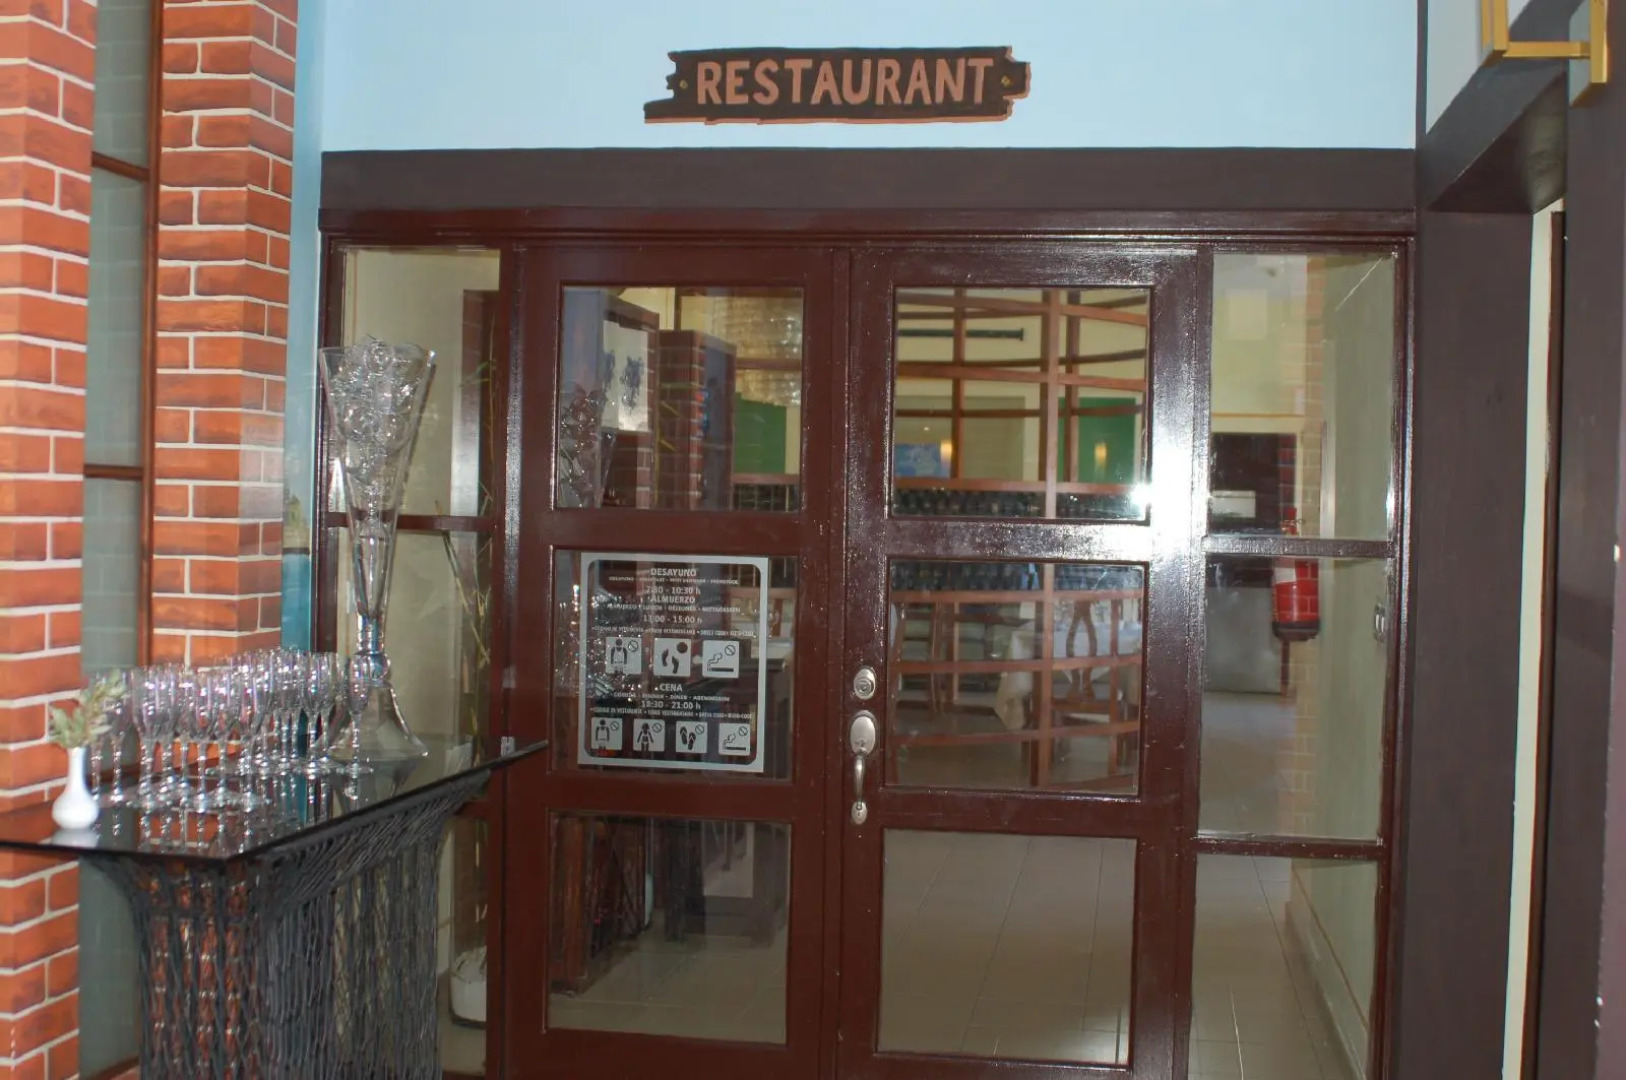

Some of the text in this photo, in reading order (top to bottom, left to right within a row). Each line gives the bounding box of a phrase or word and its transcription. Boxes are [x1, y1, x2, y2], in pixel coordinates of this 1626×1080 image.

[696, 58, 994, 105] RESTAURANT
[650, 568, 697, 577] DESAYUNO
[671, 586, 693, 595] 10:30
[650, 594, 696, 604] ALMUERZO
[673, 615, 695, 624] 15:00
[660, 683, 682, 692] CENA
[641, 700, 664, 708] 18:30
[671, 701, 694, 709] 21:00
[695, 701, 701, 710] h
